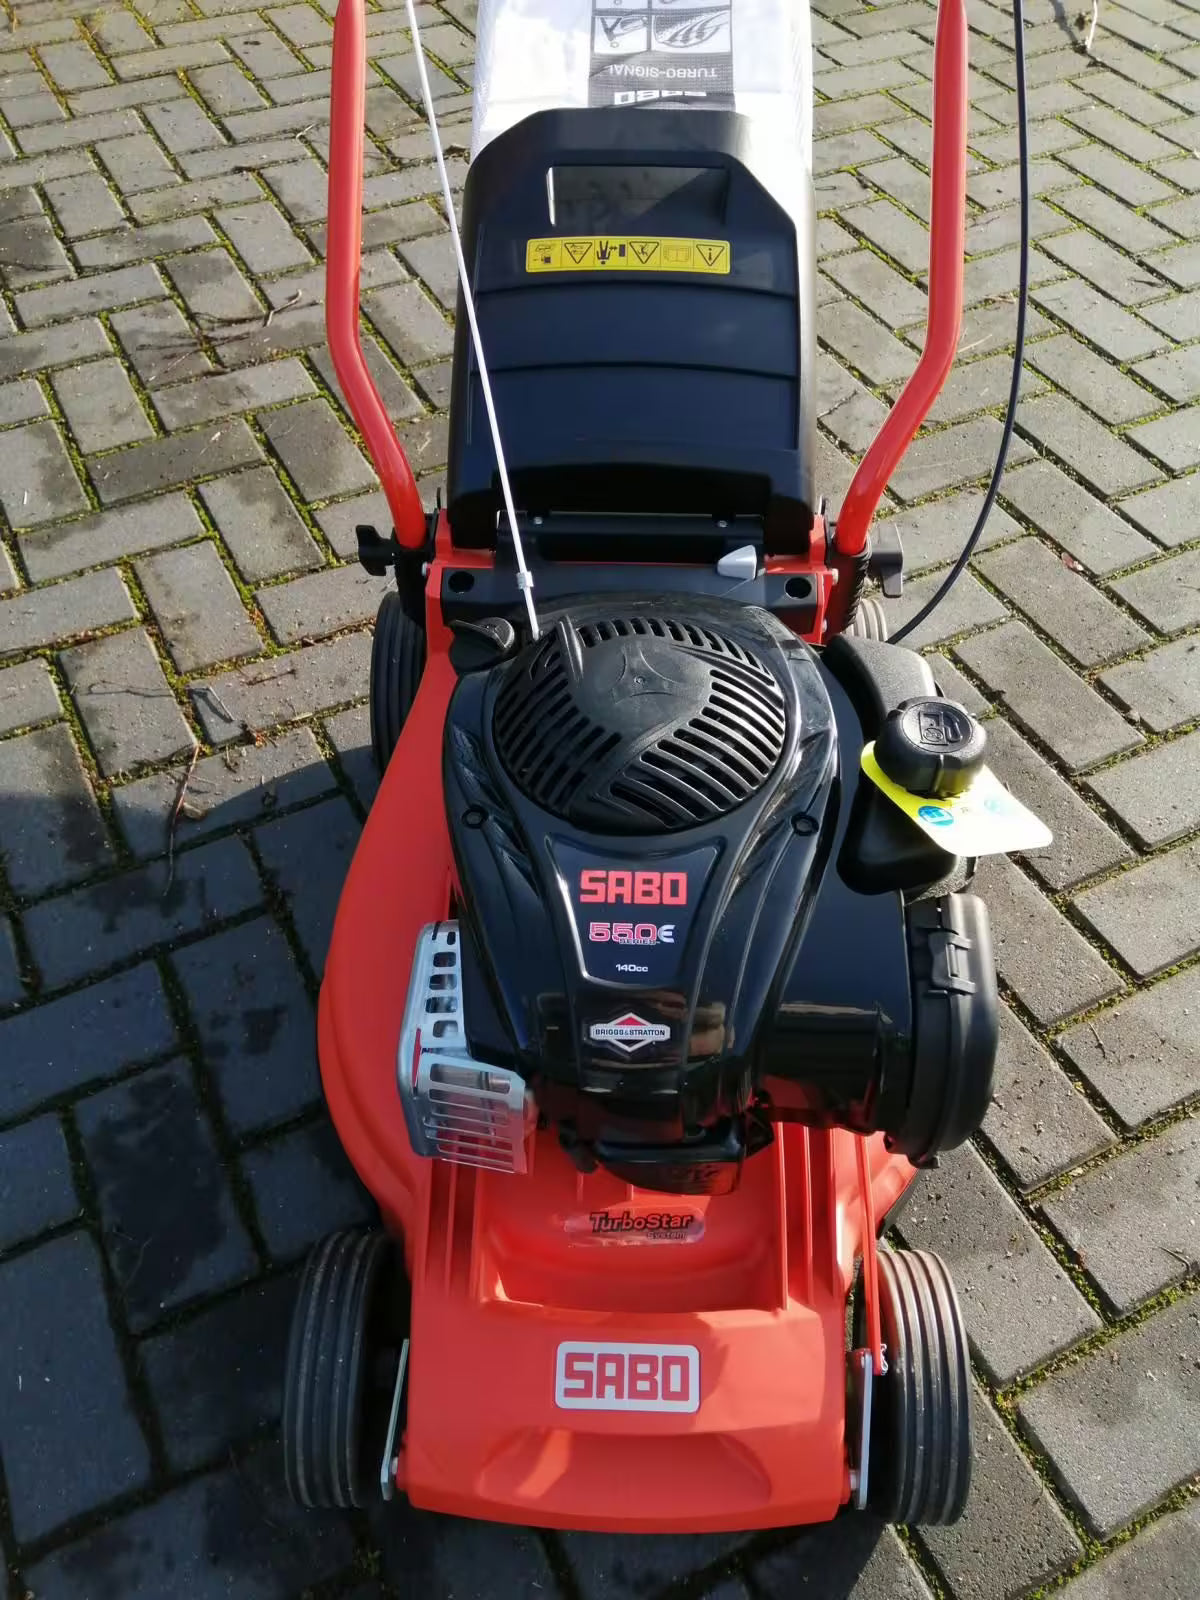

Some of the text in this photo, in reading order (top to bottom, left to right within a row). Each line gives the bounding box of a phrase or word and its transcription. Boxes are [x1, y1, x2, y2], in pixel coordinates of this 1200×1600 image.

[608, 63, 718, 79] TURBO-SIGNAL
[579, 869, 688, 906] SABO
[615, 963, 649, 973] 140cc
[589, 1211, 694, 1232] TurboStar
[563, 1352, 690, 1402] SABO
